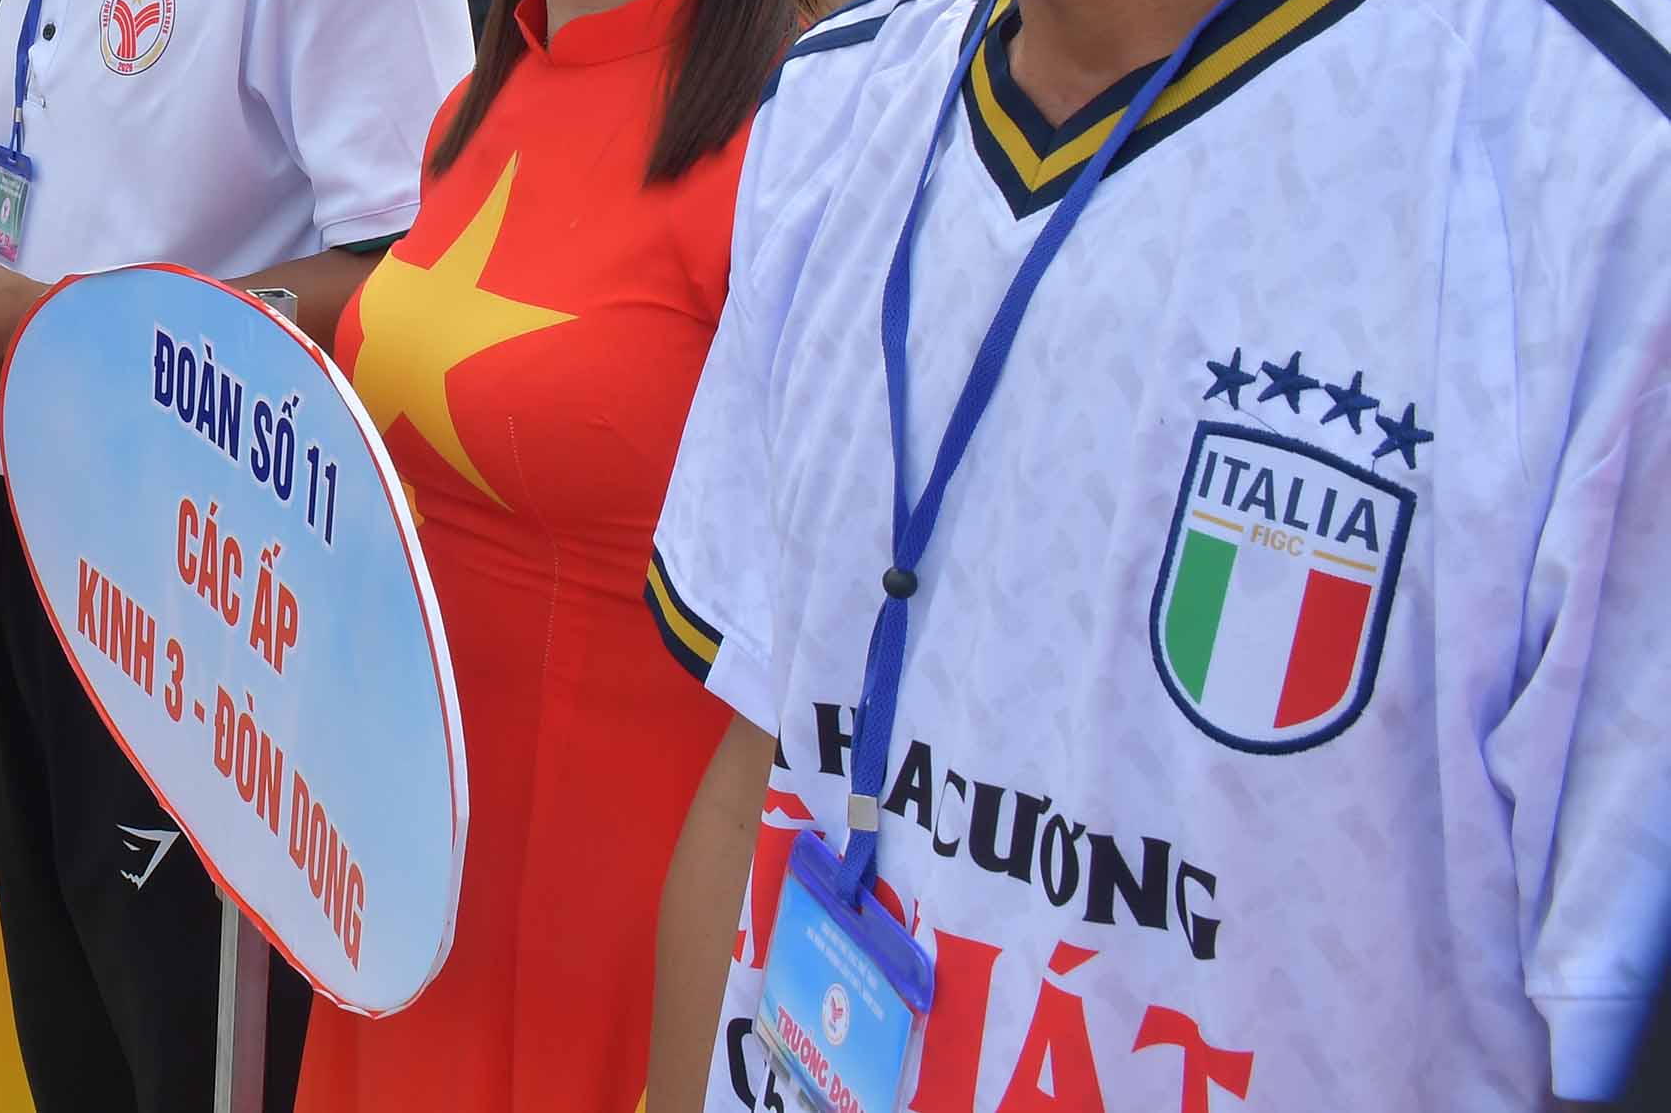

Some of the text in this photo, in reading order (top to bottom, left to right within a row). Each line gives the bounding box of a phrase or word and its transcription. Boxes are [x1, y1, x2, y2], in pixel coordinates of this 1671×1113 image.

[153, 329, 338, 546] ĐOÀN SỐ 11
[1197, 449, 1380, 553] ITALIA
[176, 497, 299, 676] CÁC ẤP
[1249, 522, 1306, 557] FIGC
[77, 557, 157, 697] KINH
[164, 637, 185, 722] 3
[214, 683, 283, 837] ĐÒN
[288, 769, 365, 973] DONG
